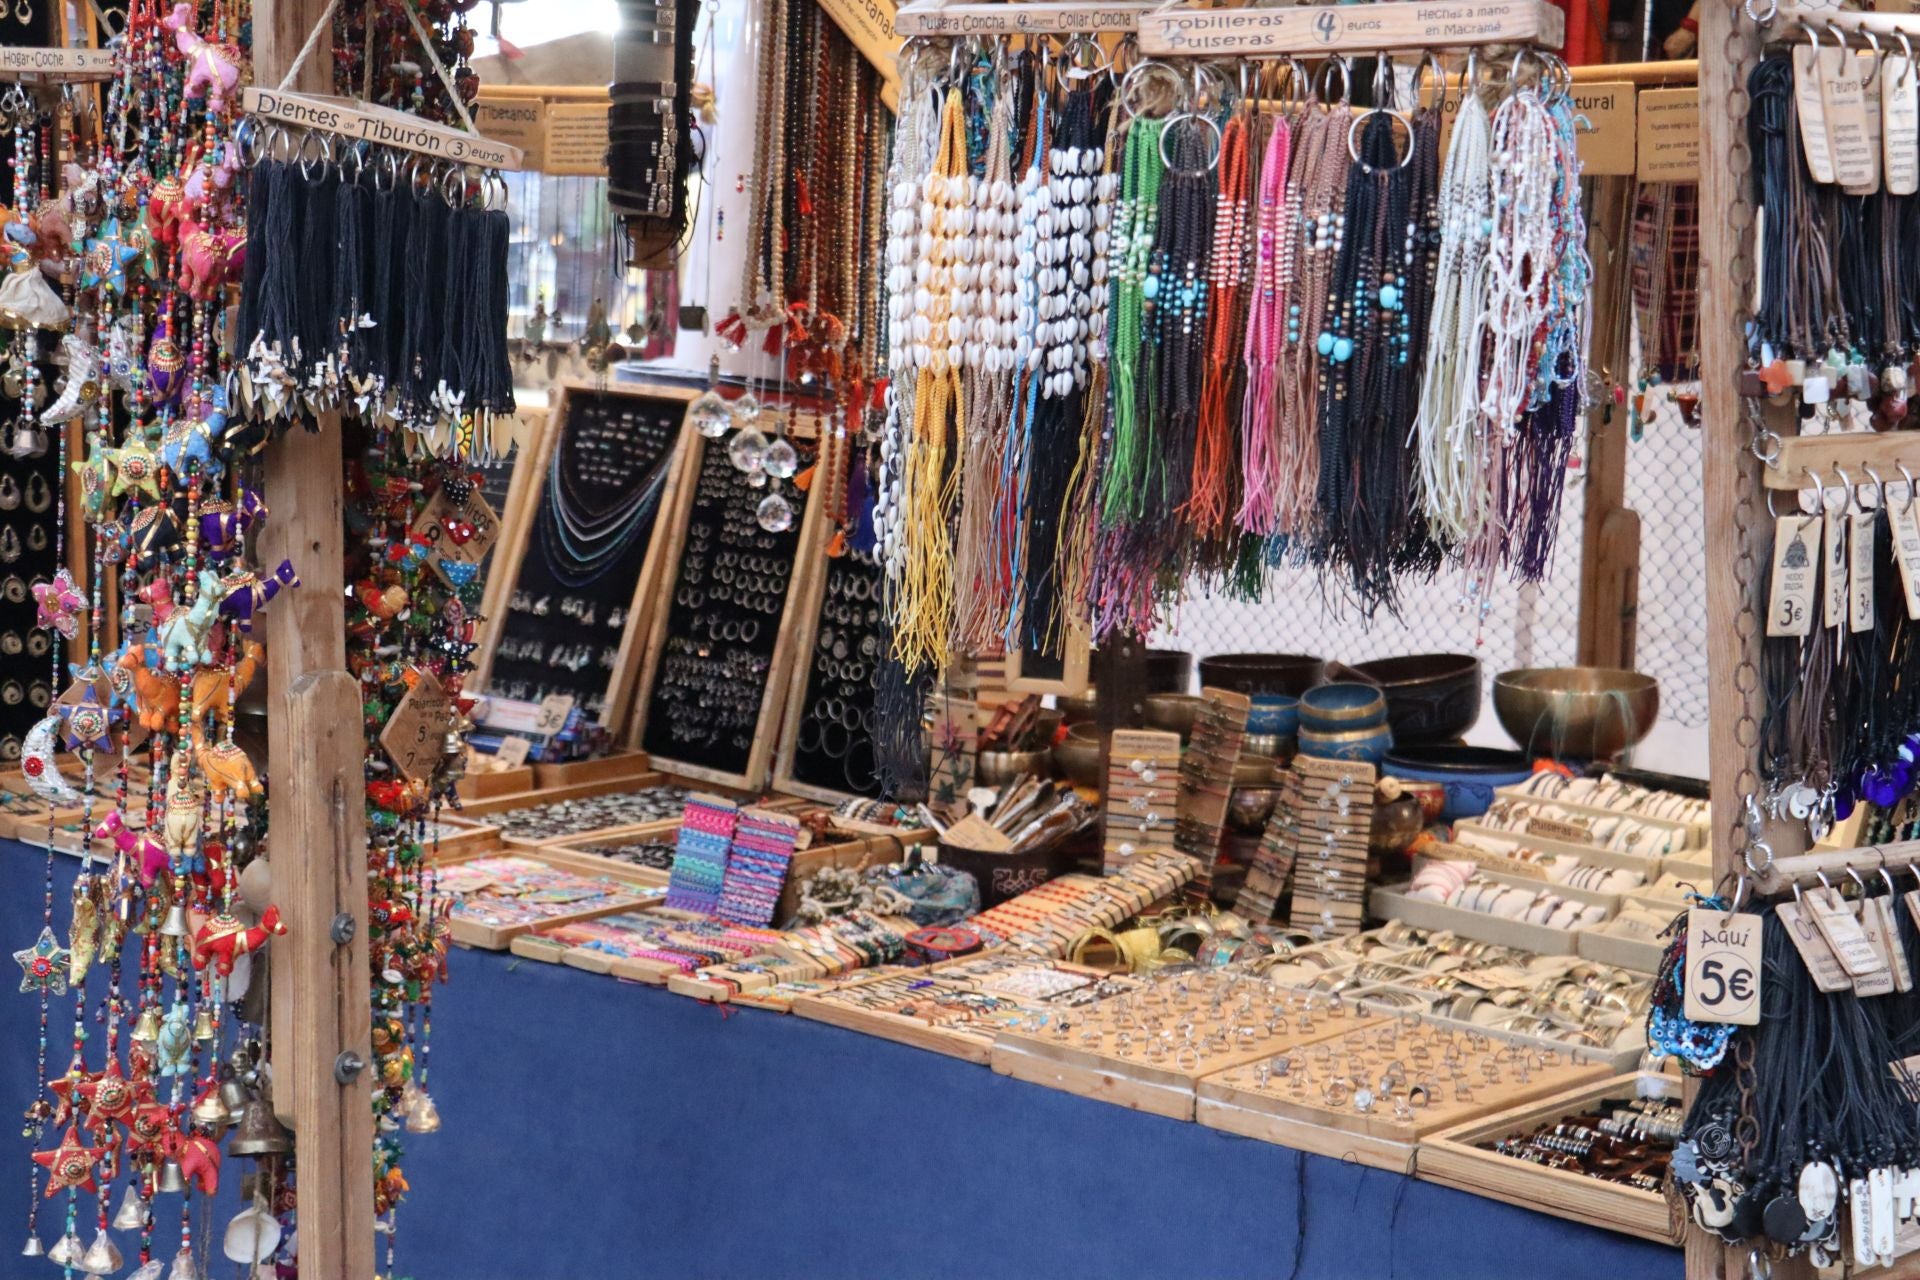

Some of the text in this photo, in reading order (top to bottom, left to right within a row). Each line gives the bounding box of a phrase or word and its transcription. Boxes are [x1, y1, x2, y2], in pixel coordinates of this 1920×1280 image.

[918, 14, 959, 31] Pulsera
[962, 14, 1005, 31] Concha
[1016, 13, 1028, 28] 4
[1058, 11, 1089, 29] Collar
[1092, 11, 1131, 28] Concha
[1417, 6, 1511, 21] Hechas a mano
[1158, 15, 1284, 34] Tobilleras
[1316, 12, 1382, 42] 4 euros
[1425, 21, 1501, 36] en Macramé
[1168, 34, 1275, 49] Pulseras
[77, 54, 85, 66] 5
[1827, 81, 1858, 94] Tauro
[1575, 95, 1614, 110] tural
[257, 93, 505, 163] Dientes de Tiburón 3 euros
[1780, 600, 1802, 626] 3€
[417, 726, 426, 742] 5
[1531, 818, 1572, 837] Pulseras
[1701, 928, 1751, 949] Aquí
[1700, 960, 1754, 1006] 5€
